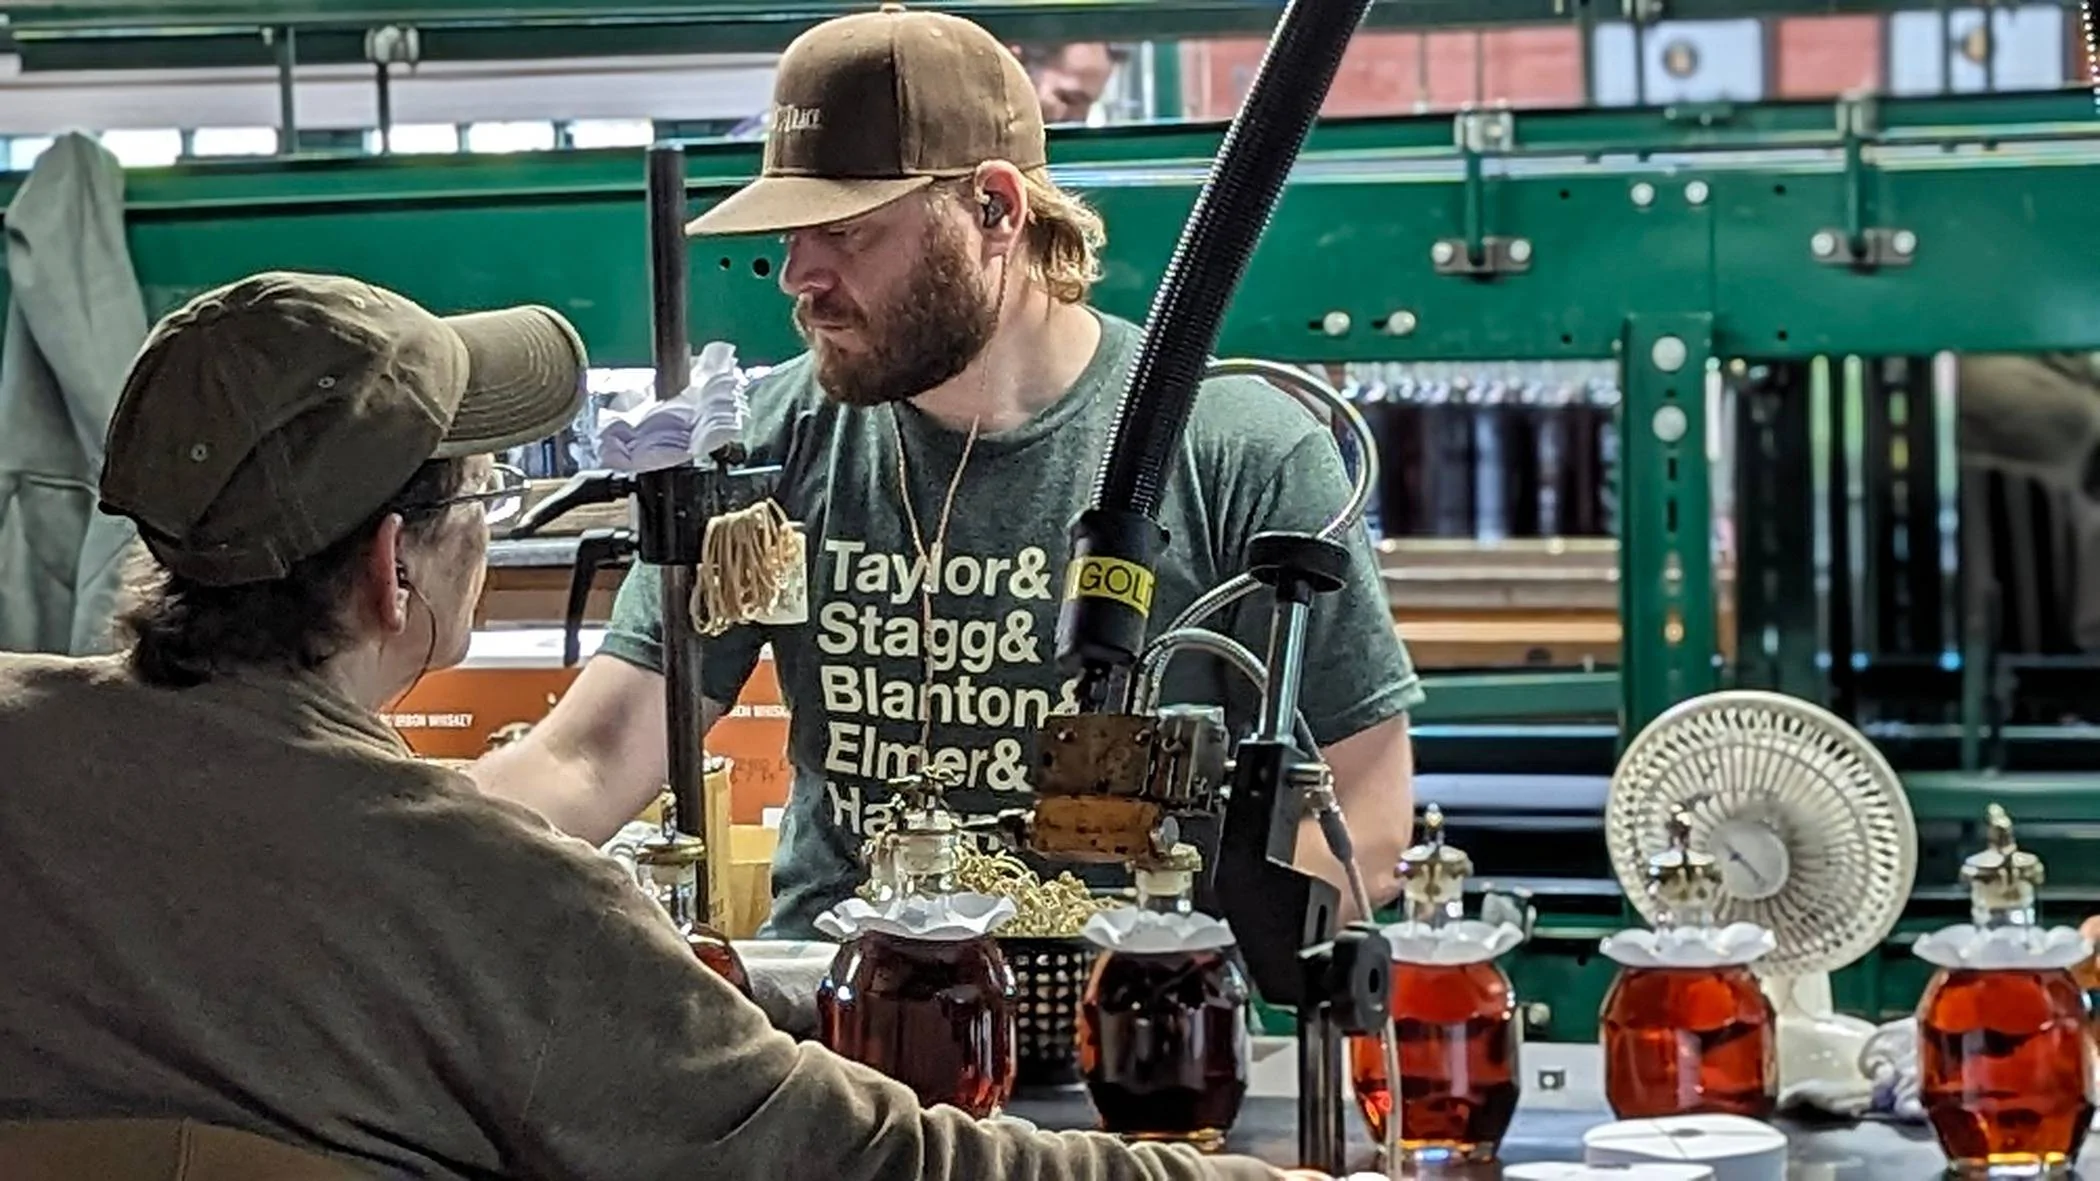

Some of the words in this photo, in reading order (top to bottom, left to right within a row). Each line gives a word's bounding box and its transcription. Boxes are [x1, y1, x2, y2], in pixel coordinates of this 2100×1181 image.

[824, 539, 1052, 605] Taylor&
[816, 600, 1042, 674] Stagg&
[824, 720, 1034, 792] Elmer&
